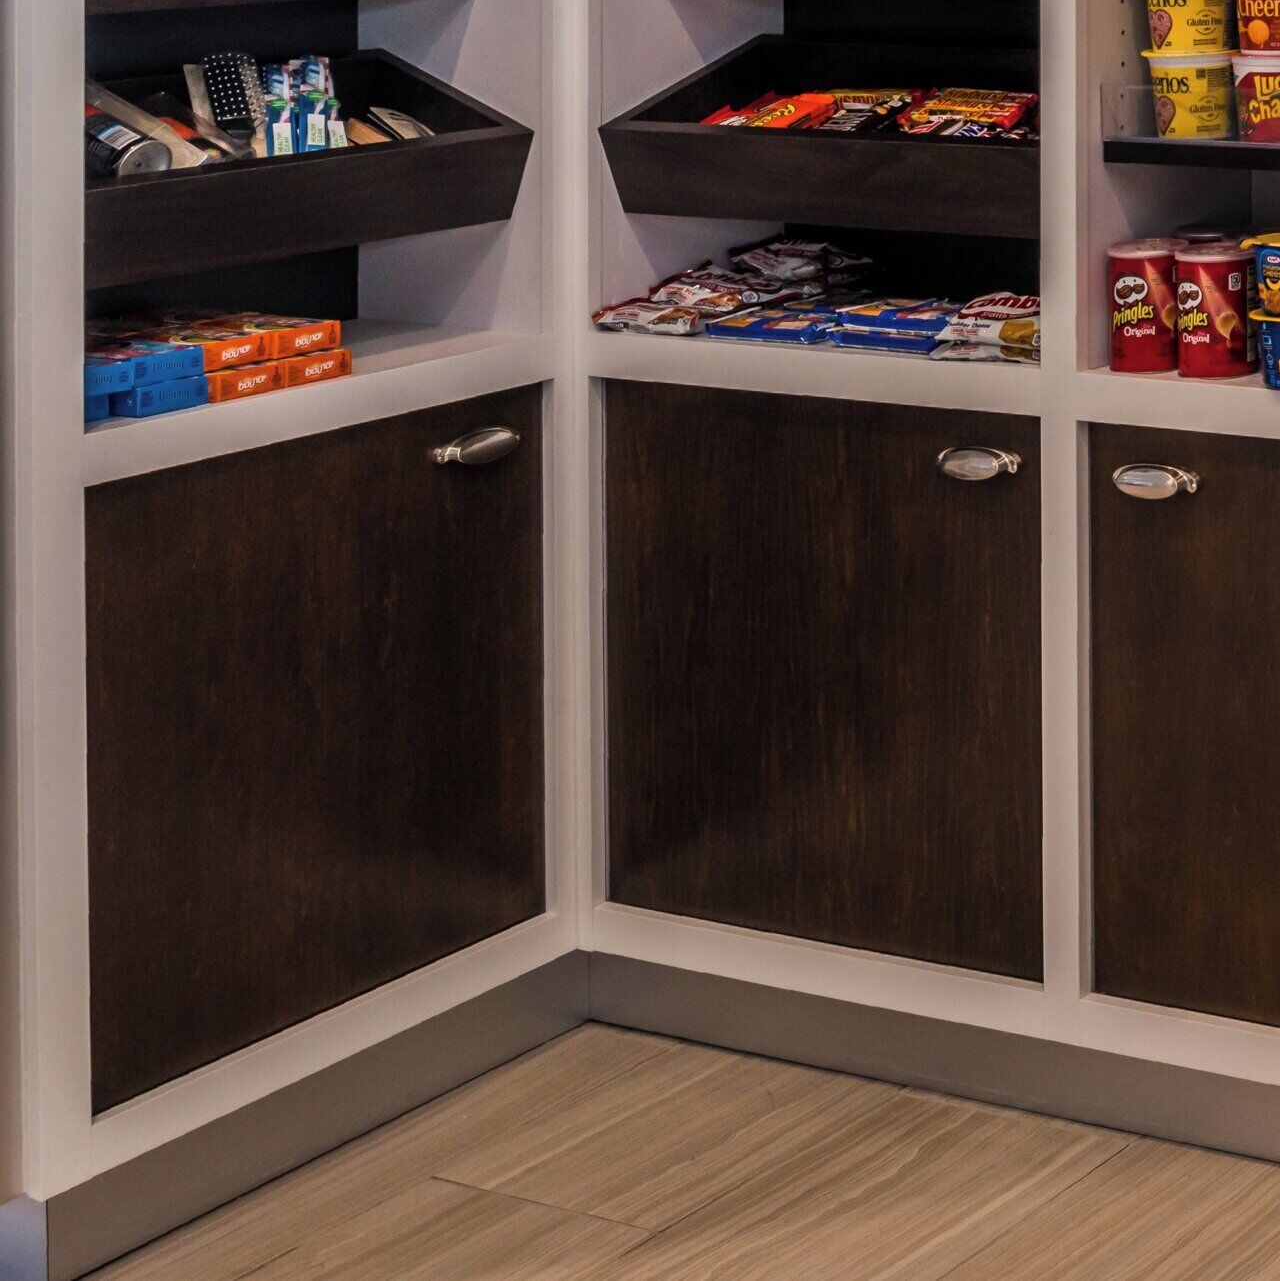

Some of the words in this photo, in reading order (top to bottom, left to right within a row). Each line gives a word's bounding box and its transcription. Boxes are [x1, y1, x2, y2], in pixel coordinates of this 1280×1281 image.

[1113, 303, 1154, 332] Pringles
[295, 331, 323, 347] bounce
[1124, 326, 1155, 338] Original
[1183, 332, 1209, 344] Original
[222, 344, 251, 360] bounce
[238, 374, 267, 391] bounce
